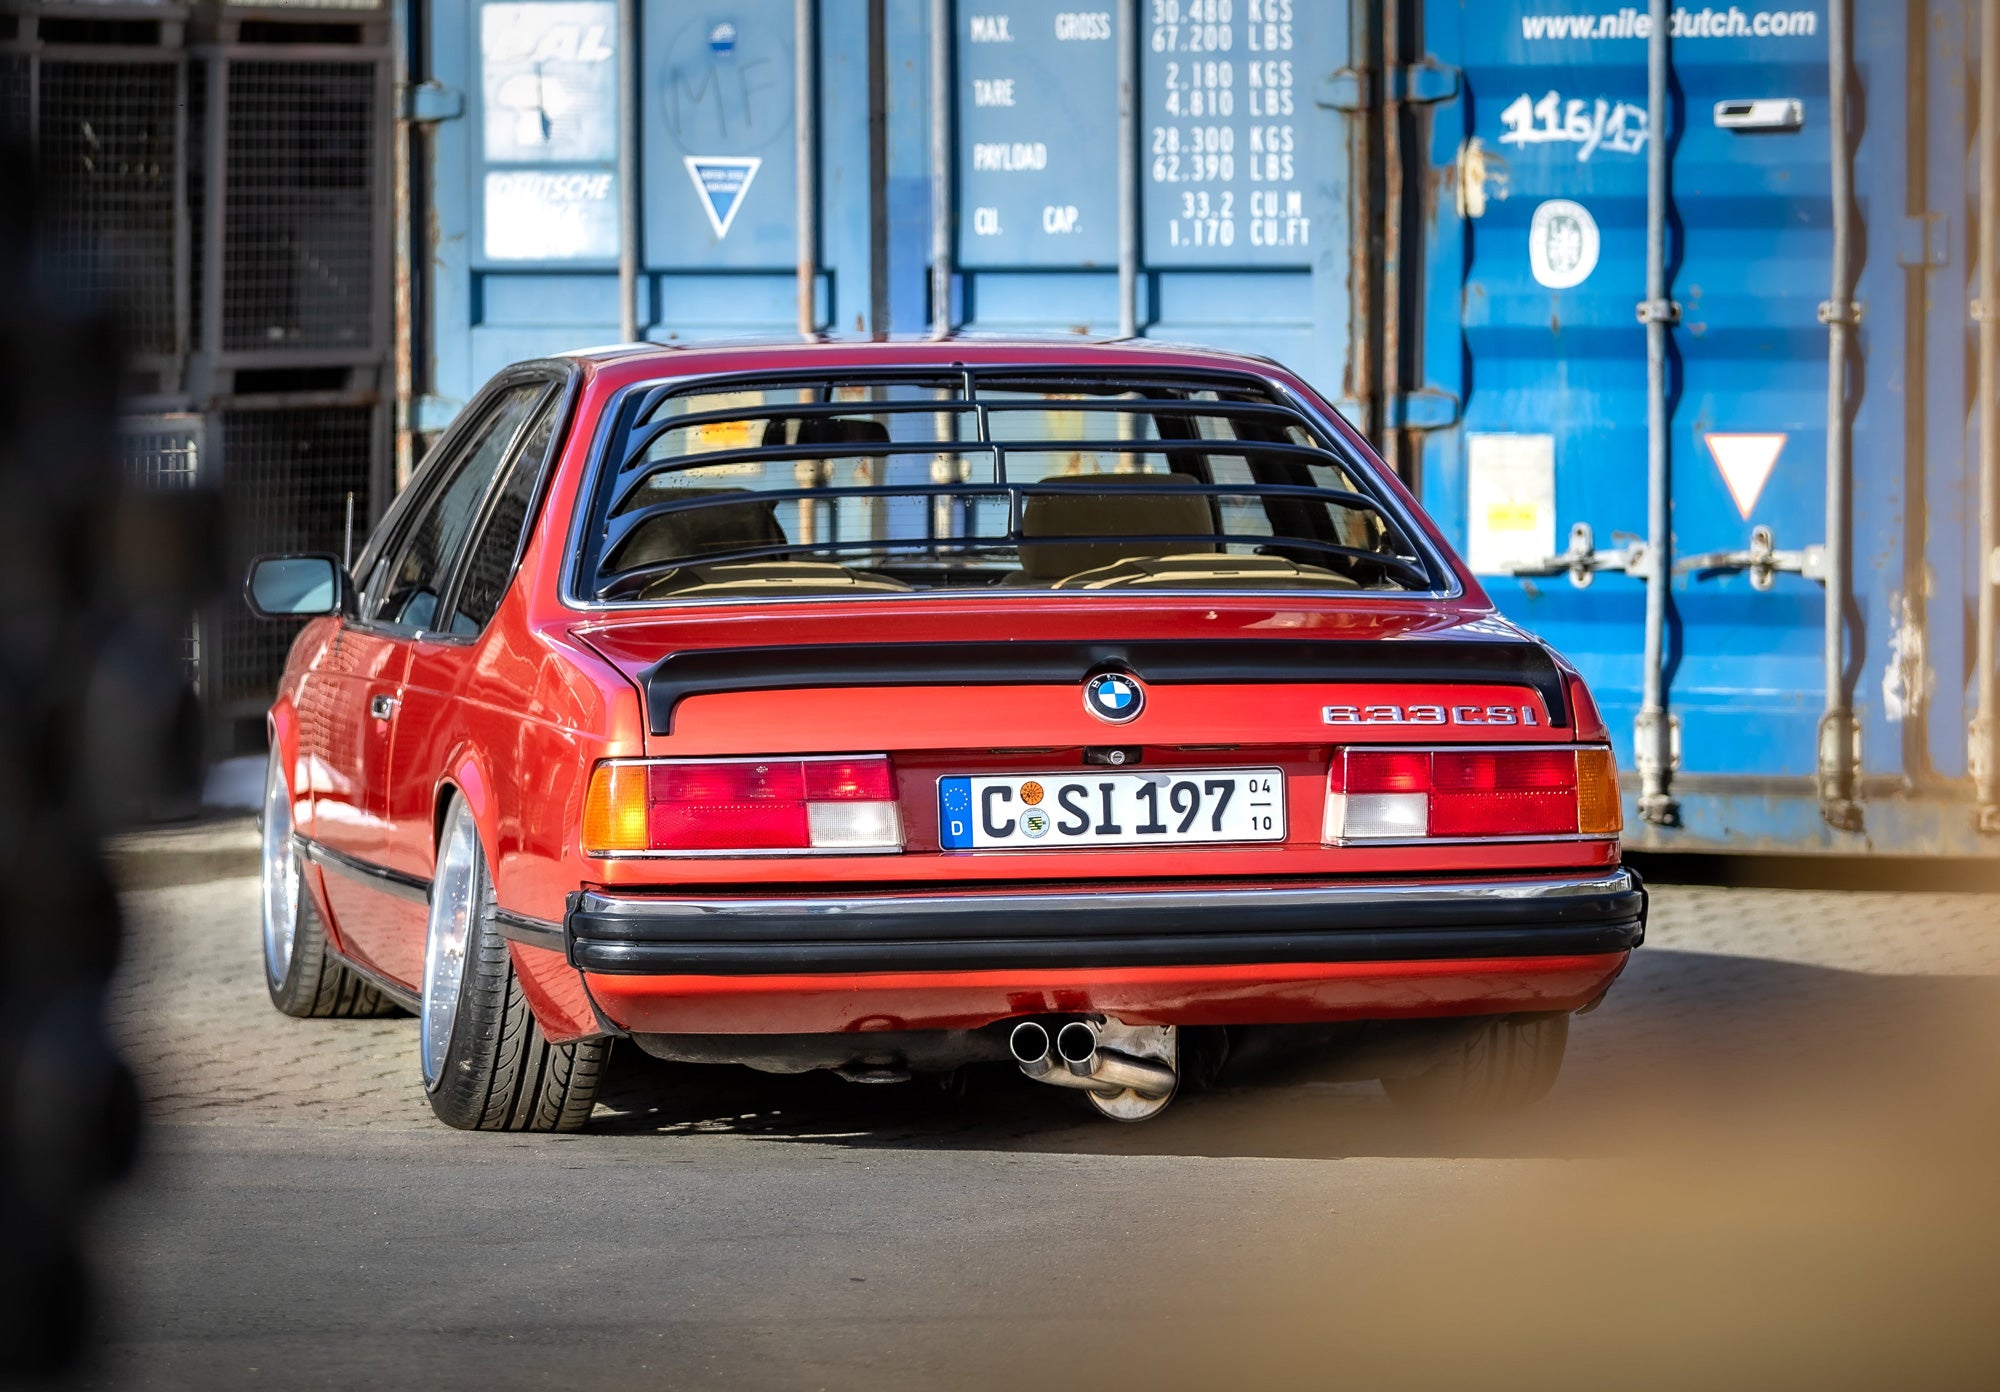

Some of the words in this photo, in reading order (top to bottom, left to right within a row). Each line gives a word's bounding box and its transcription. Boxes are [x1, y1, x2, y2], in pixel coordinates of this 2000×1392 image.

[1152, 0, 1233, 24] 30.480
[1248, 0, 1293, 23] KGS
[970, 15, 1015, 42] MAX.
[1055, 12, 1111, 41] GROSS
[1151, 24, 1233, 52] 67.200
[1248, 23, 1293, 51] LBS
[1165, 61, 1233, 90] 2.180
[1249, 60, 1294, 88] KGS
[973, 79, 1016, 107] TARE
[1165, 88, 1234, 117] 4.810
[1249, 88, 1294, 116] LBS
[1152, 126, 1234, 154] 28.300
[1250, 125, 1294, 153] KGS
[973, 142, 1047, 171] PAYLOAD
[1152, 154, 1234, 182] 62.390
[1250, 153, 1294, 181] LBS
[1182, 191, 1234, 219] 33.2
[1043, 205, 1083, 235] CAP.
[1169, 218, 1234, 247] 1.170
[1250, 217, 1311, 246] CU.FT
[1091, 673, 1136, 690] BMW
[1248, 778, 1272, 794] 04
[981, 785, 1016, 838] C
[1251, 816, 1272, 831] 10
[951, 820, 964, 836] D
